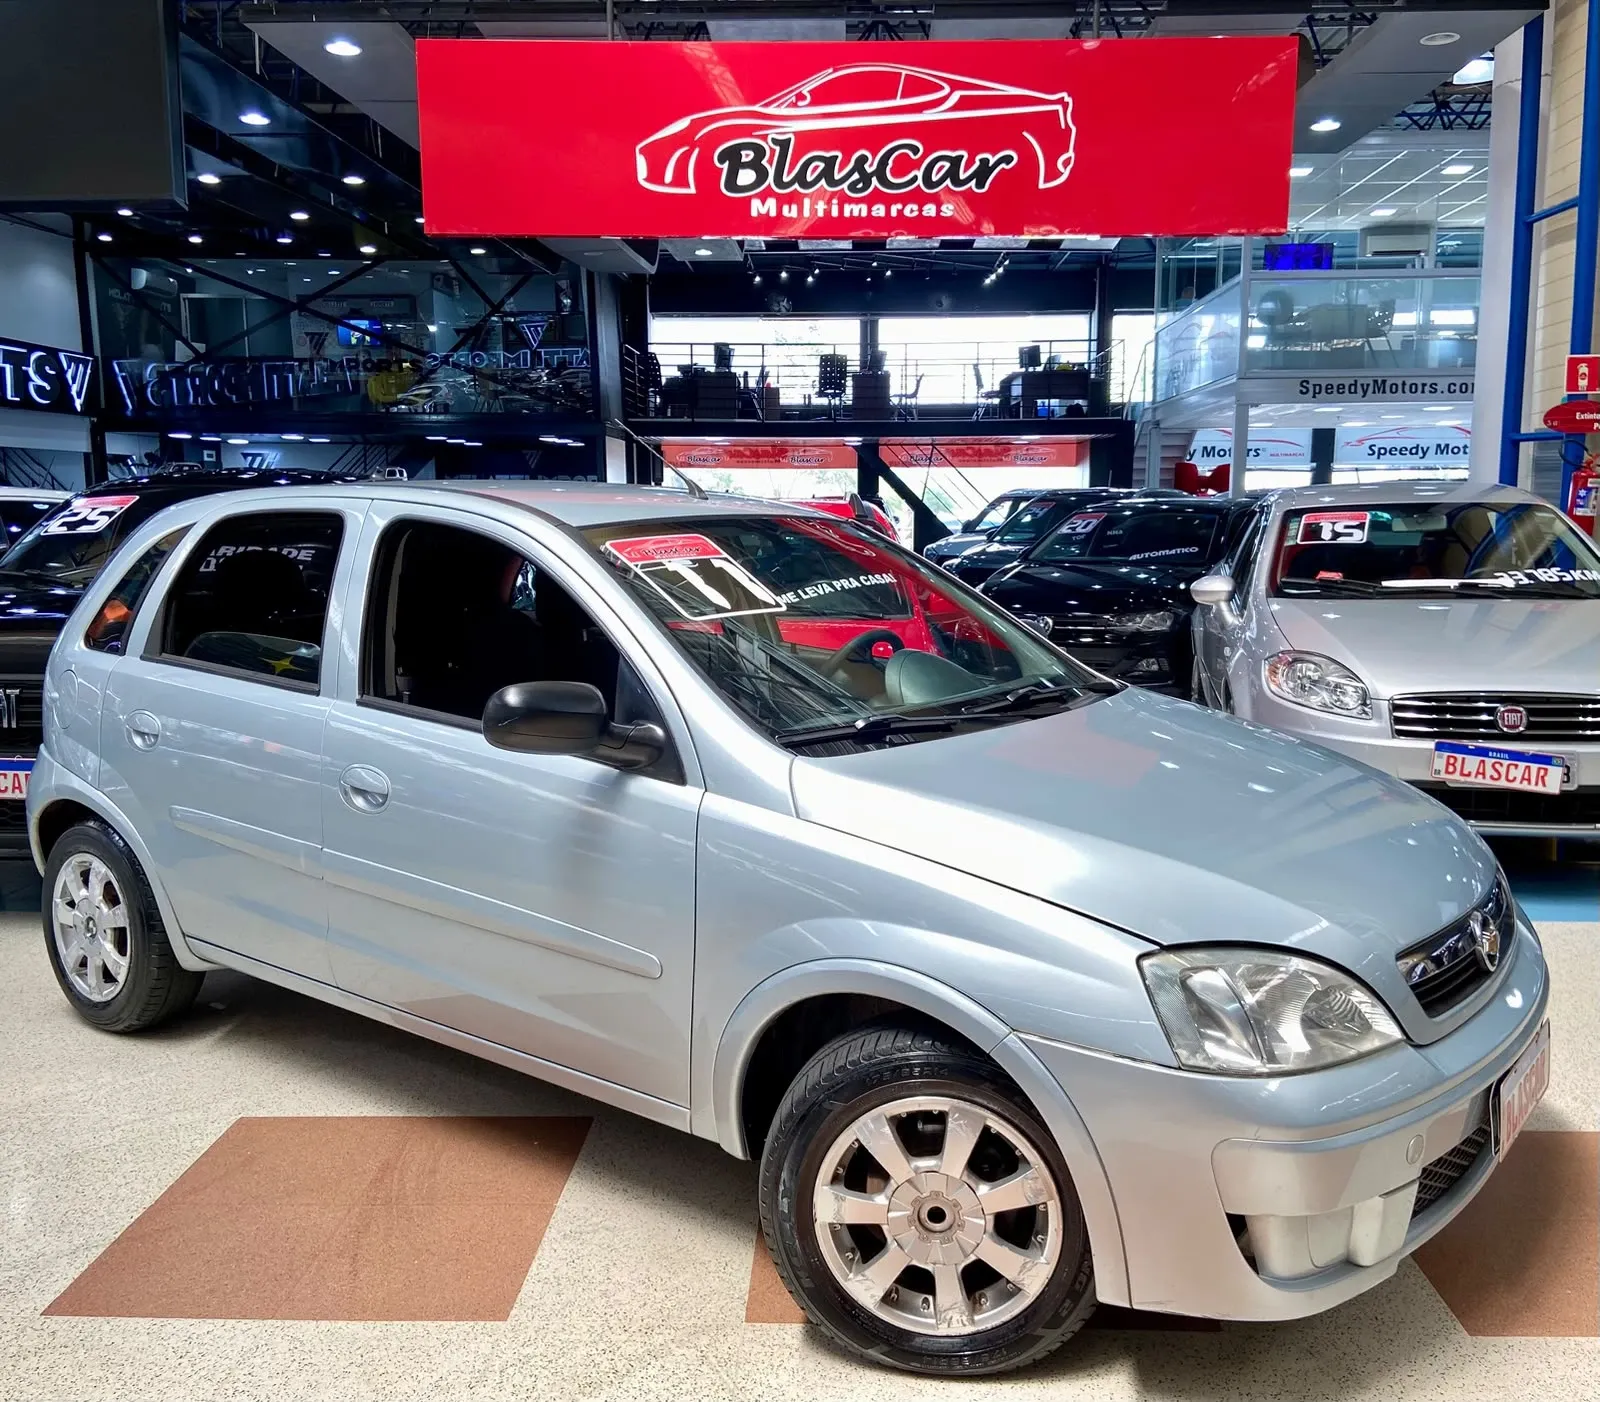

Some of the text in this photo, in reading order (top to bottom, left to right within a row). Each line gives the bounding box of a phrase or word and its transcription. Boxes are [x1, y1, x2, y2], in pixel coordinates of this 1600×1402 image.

[714, 134, 1019, 196] BlasCar
[750, 198, 955, 218] Multimarcas
[1367, 443, 1430, 460] Speedy
[47, 507, 120, 533] 25
[1319, 521, 1364, 541] 15
[798, 583, 835, 600] LEVA
[831, 577, 861, 592] PRA
[1504, 712, 1522, 726] FIAT
[1444, 754, 1549, 787] BLASCAR
